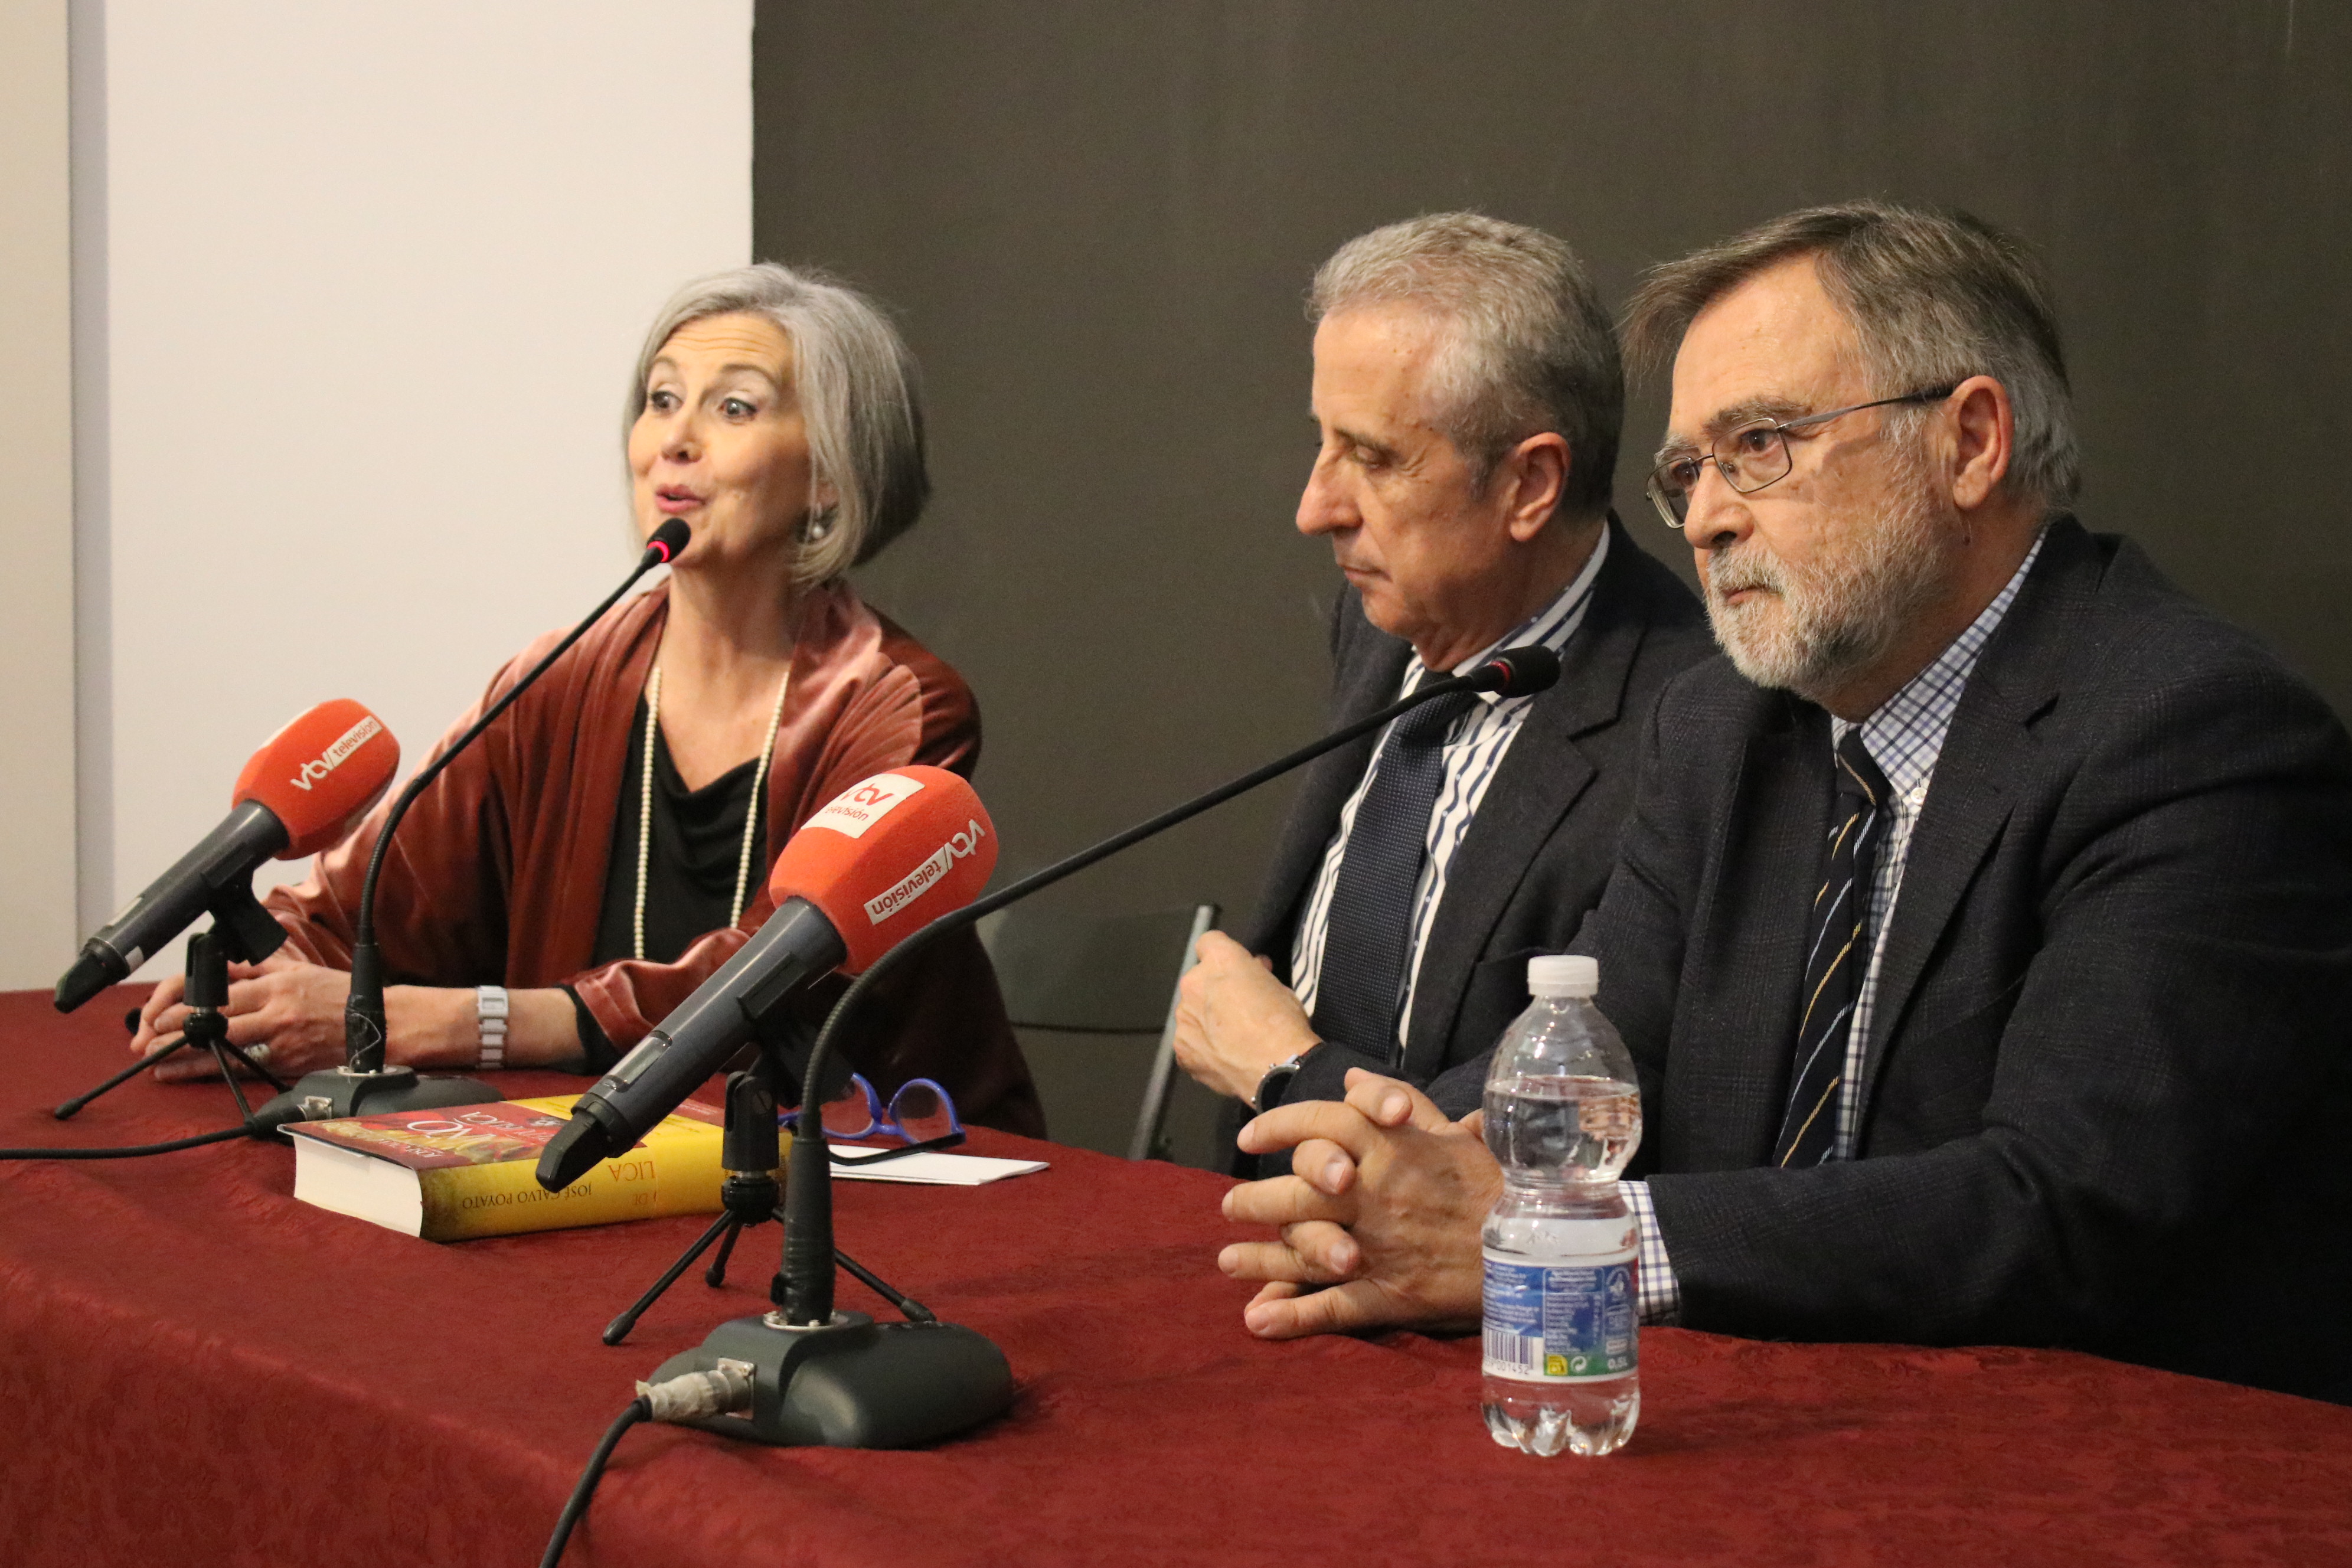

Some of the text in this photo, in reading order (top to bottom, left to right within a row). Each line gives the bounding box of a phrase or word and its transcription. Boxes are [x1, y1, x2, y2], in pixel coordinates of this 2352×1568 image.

[871, 860, 942, 916] televisión
[563, 1181, 593, 1200] JOSÉ
[462, 1193, 512, 1209] POYATO
